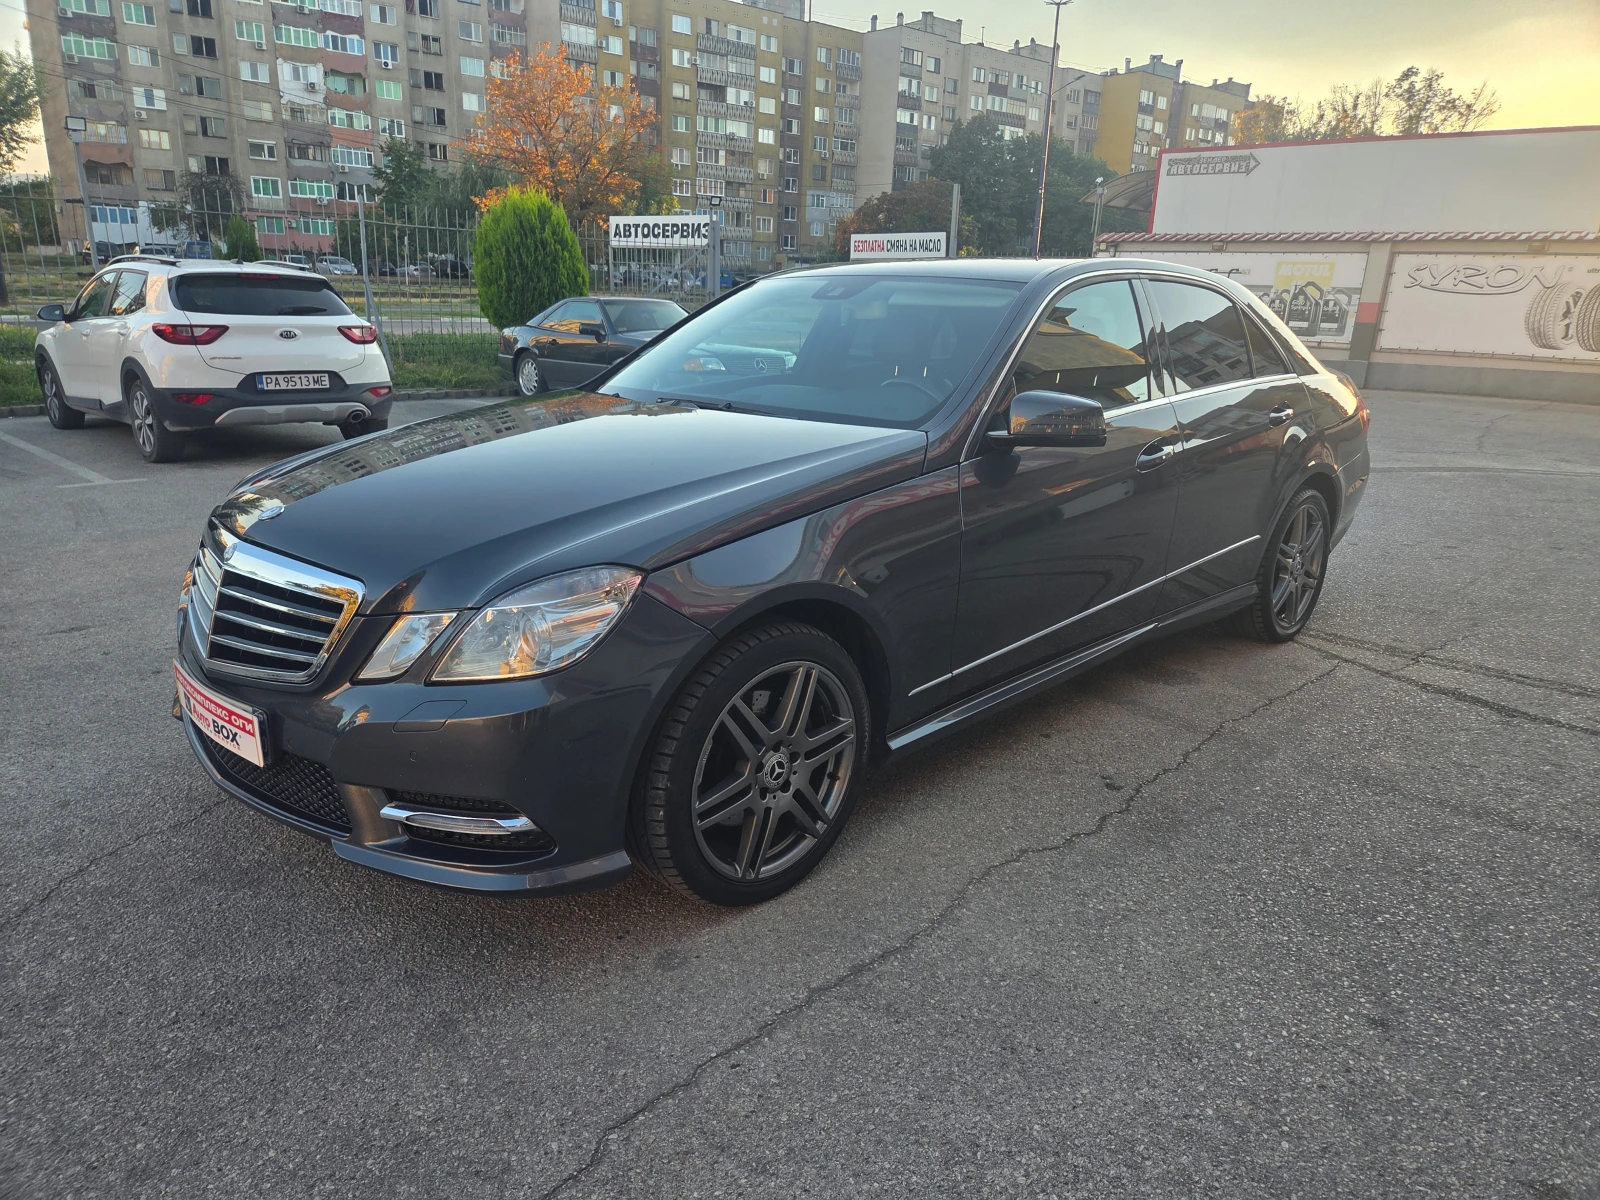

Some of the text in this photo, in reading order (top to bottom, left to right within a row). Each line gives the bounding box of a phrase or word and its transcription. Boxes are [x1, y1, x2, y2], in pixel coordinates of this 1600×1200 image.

[1170, 161, 1247, 175] АВТОСЕРВИЗ
[613, 222, 710, 239] АВТОСЕРВИЗ
[853, 238, 942, 252] БЕЗПЛАТНА СМЯНА НА МАСЛО
[1278, 264, 1330, 276] MOTUL
[1404, 264, 1566, 292] SYRON
[283, 375, 311, 388] 9513
[231, 715, 254, 734] ОГИ
[212, 718, 240, 747] BOX
